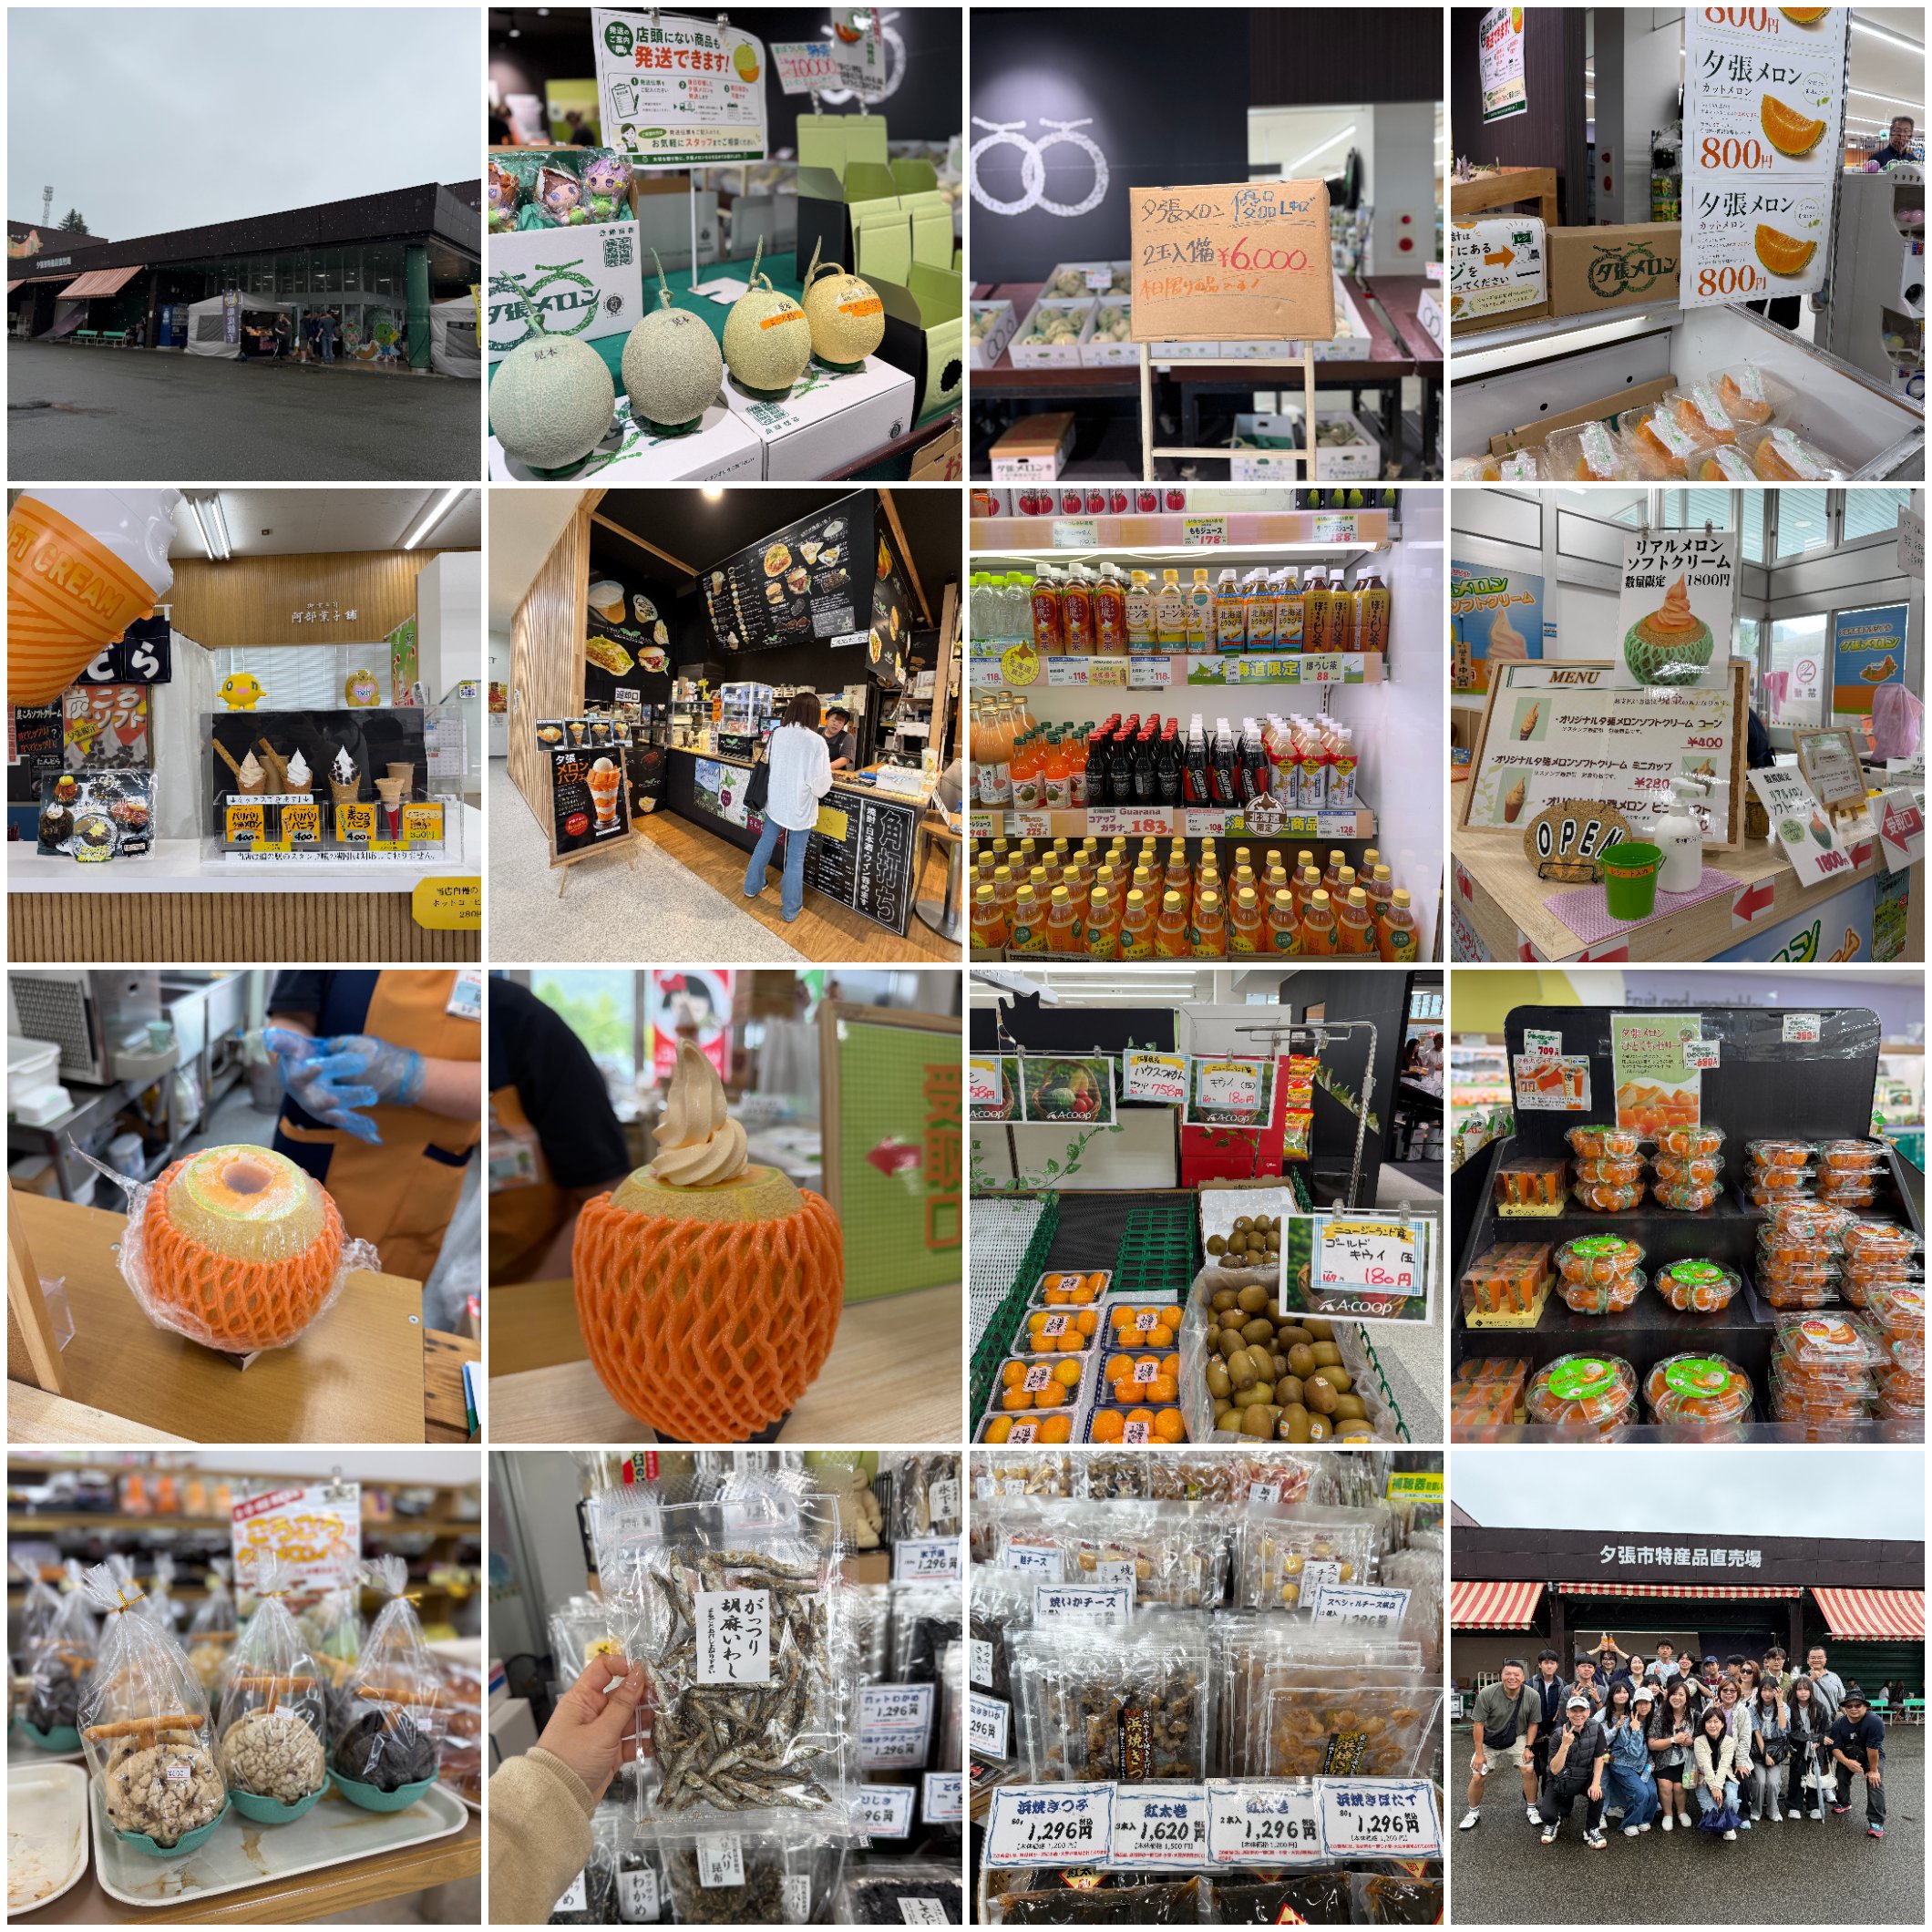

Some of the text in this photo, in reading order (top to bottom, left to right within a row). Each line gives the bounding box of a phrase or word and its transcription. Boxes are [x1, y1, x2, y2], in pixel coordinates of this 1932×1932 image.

[609, 26, 629, 35] 発送の
[635, 26, 721, 49] 店頭にない商品も
[610, 36, 630, 45] ご案内
[634, 46, 729, 73] 発送できます!
[1702, 49, 1803, 86] 夕張メロン
[1702, 83, 1752, 96] カットメロン
[1701, 137, 1773, 170] 800円
[1142, 198, 1225, 224] 夕張メロン
[1698, 192, 1794, 219] 夕張メロン
[1700, 221, 1747, 231] カットメロン
[1595, 257, 1678, 283] 夕張メロン
[1698, 265, 1766, 296] 800円
[535, 348, 557, 362] 見本
[1189, 527, 1223, 536] ももジュース
[1637, 539, 1723, 555] リアルメロン
[1628, 554, 1731, 571] ソフトクリーム
[7, 521, 125, 622] FT CREAM
[1625, 573, 1730, 589] 数量限定 1800円
[1035, 596, 1046, 618] 綾鷹
[1068, 596, 1079, 619] 綾鷹
[1100, 596, 1111, 619] 綾鷹
[1451, 591, 1535, 615] ソフトクリーム
[1126, 609, 1149, 620] コーン茶
[1159, 609, 1186, 620] コーン茶
[1220, 610, 1242, 620] 北海道
[1251, 610, 1273, 620] 北海道
[1279, 608, 1302, 618] 北海道
[1220, 619, 1242, 627] とうきび茶
[1311, 601, 1326, 647] ほうじ茶
[1332, 601, 1344, 646] ほうじ茶
[1368, 601, 1382, 646] ほうじ茶
[1040, 631, 1050, 652] 番茶
[1072, 631, 1081, 652] 番茶
[1104, 631, 1113, 652] 番茶
[1838, 636, 1902, 653] 夕張メロン
[1306, 662, 1338, 671] ほうじ茶
[986, 673, 999, 681] 118
[1073, 672, 1085, 681] 118
[1155, 672, 1167, 681] 118
[1316, 672, 1329, 682] 88
[1549, 671, 1601, 684] MENU
[95, 709, 146, 729] ソフト
[1559, 715, 1722, 729] オリジナル夕張メロンソフトクリーム コーン
[1688, 736, 1723, 748] ¥400
[556, 753, 576, 766] 夕張
[1495, 755, 1672, 772] オリジナル夕張メロンソフトクリーム ミニカップ
[558, 762, 589, 776] メロン
[558, 772, 588, 785] パフェ
[1194, 769, 1208, 803] Guarana
[1219, 769, 1234, 801] Guarana
[1634, 777, 1670, 789] ¥280
[1763, 772, 1792, 785] 数量限定
[1770, 786, 1804, 801] リアルメロン
[1119, 807, 1161, 817] Guarana
[1249, 813, 1280, 823] 北海道
[292, 821, 315, 830] バニラ
[1088, 816, 1116, 824] コアップ
[1130, 818, 1174, 835] 183円
[1209, 823, 1222, 831] 108
[1290, 816, 1317, 830] 商品
[1886, 811, 1915, 836] 受取口
[1100, 824, 1125, 832] ガラナ
[1256, 824, 1272, 832] 限定
[1340, 826, 1352, 834] 128
[1536, 817, 1625, 860] OPEN
[875, 809, 902, 923] 角打ち
[1815, 850, 1850, 875] 1800円
[1625, 990, 1657, 1008] Fruit
[1621, 1026, 1666, 1039] 夕張メロン
[1621, 1040, 1681, 1052] ひとくちゼリー
[1151, 1084, 1184, 1097] 758円
[1228, 1092, 1255, 1104] 180円
[1333, 1225, 1408, 1240] ニュージーランド産
[1325, 1238, 1371, 1249] ゴールド
[1350, 1249, 1386, 1260] キウイ
[1364, 1267, 1413, 1287] 180円
[1392, 1476, 1427, 1491] 補聴器
[1599, 1545, 1762, 1567] 夕張市特産品直売場
[1049, 1596, 1116, 1608] 焼いかチーズ
[745, 1598, 765, 1657] がっつり
[720, 1598, 744, 1679] 胡麻いわし
[1125, 1716, 1144, 1779] 浜焼きつ
[1016, 1798, 1089, 1814] 浜焼きつぶ
[1336, 1793, 1416, 1807] 浜焼きほたて
[1144, 1804, 1187, 1819] 紅太巻
[1028, 1821, 1093, 1841] 1,296円
[1115, 1822, 1136, 1831] 3本入
[1220, 1816, 1317, 1840] 2本入 1,296円
[1358, 1814, 1420, 1834] 1,296円
[712, 1862, 723, 1885] 昆布
[632, 1875, 646, 1917] わかめ
